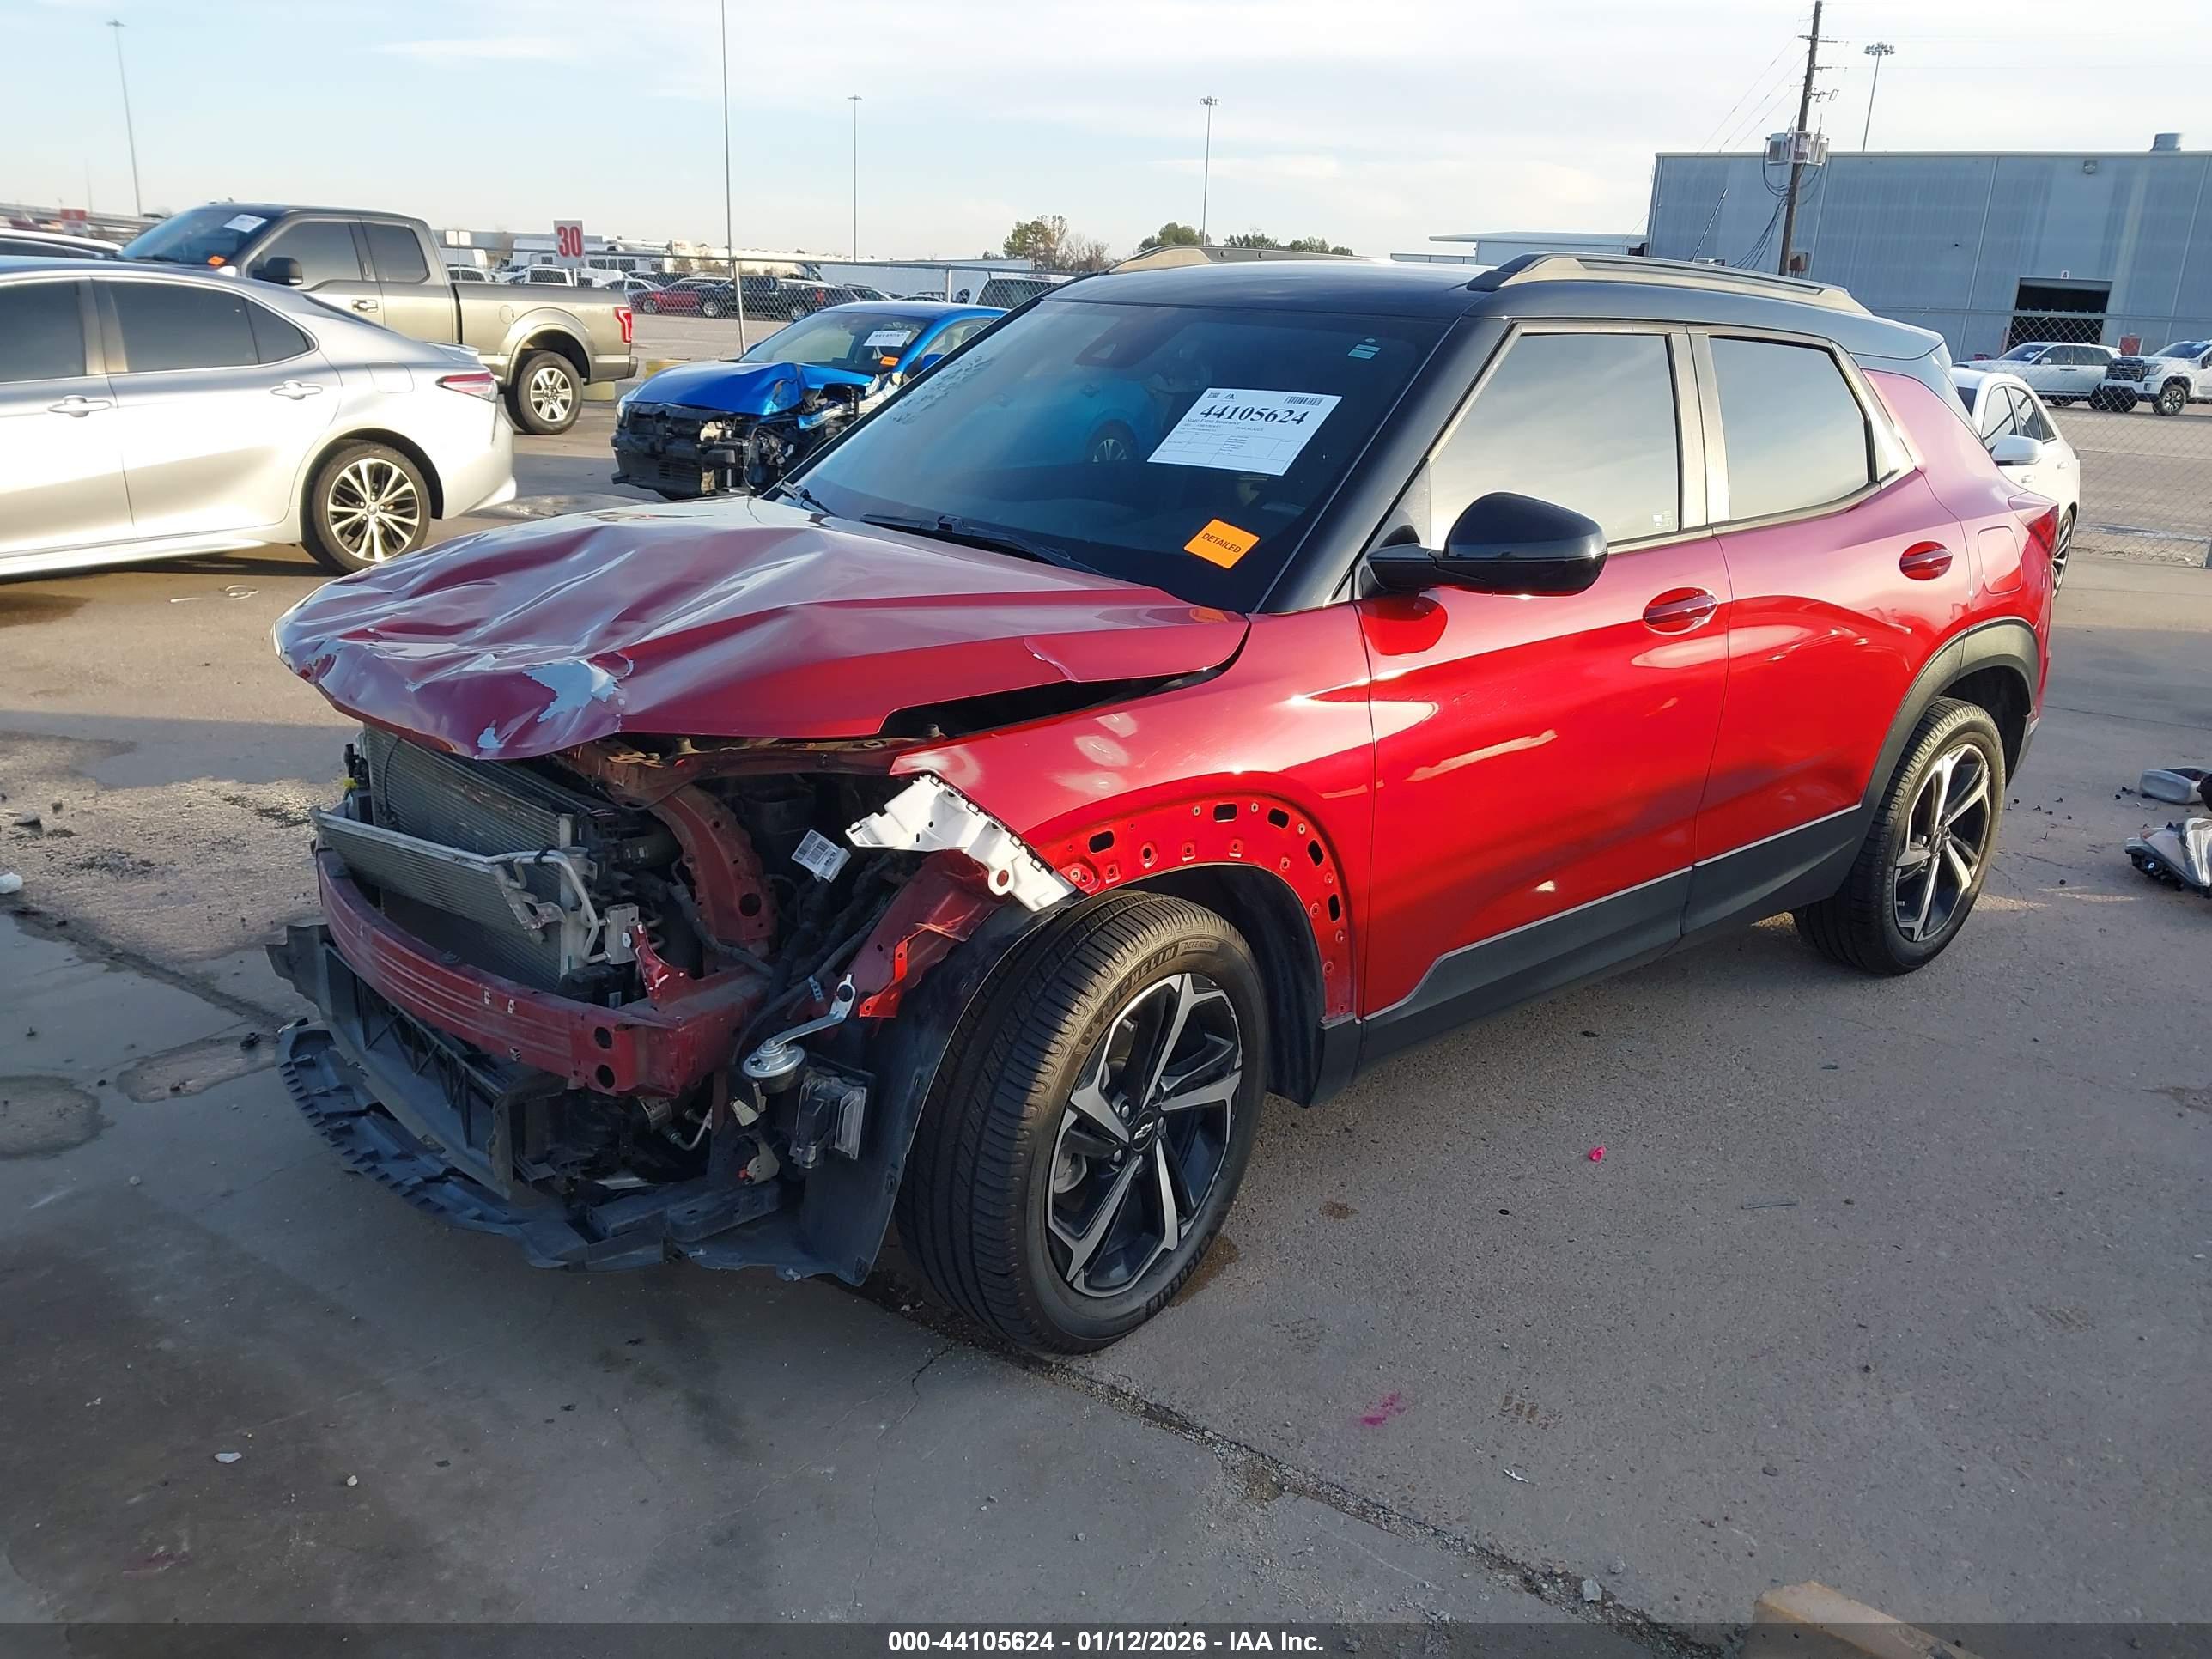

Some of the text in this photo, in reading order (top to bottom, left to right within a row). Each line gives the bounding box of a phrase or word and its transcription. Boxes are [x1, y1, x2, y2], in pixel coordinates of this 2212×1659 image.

[558, 227, 582, 257] 30
[1200, 404, 1310, 425] 44105624
[1202, 532, 1242, 553] DETAILED
[1101, 945, 1176, 1020] MICHELIN
